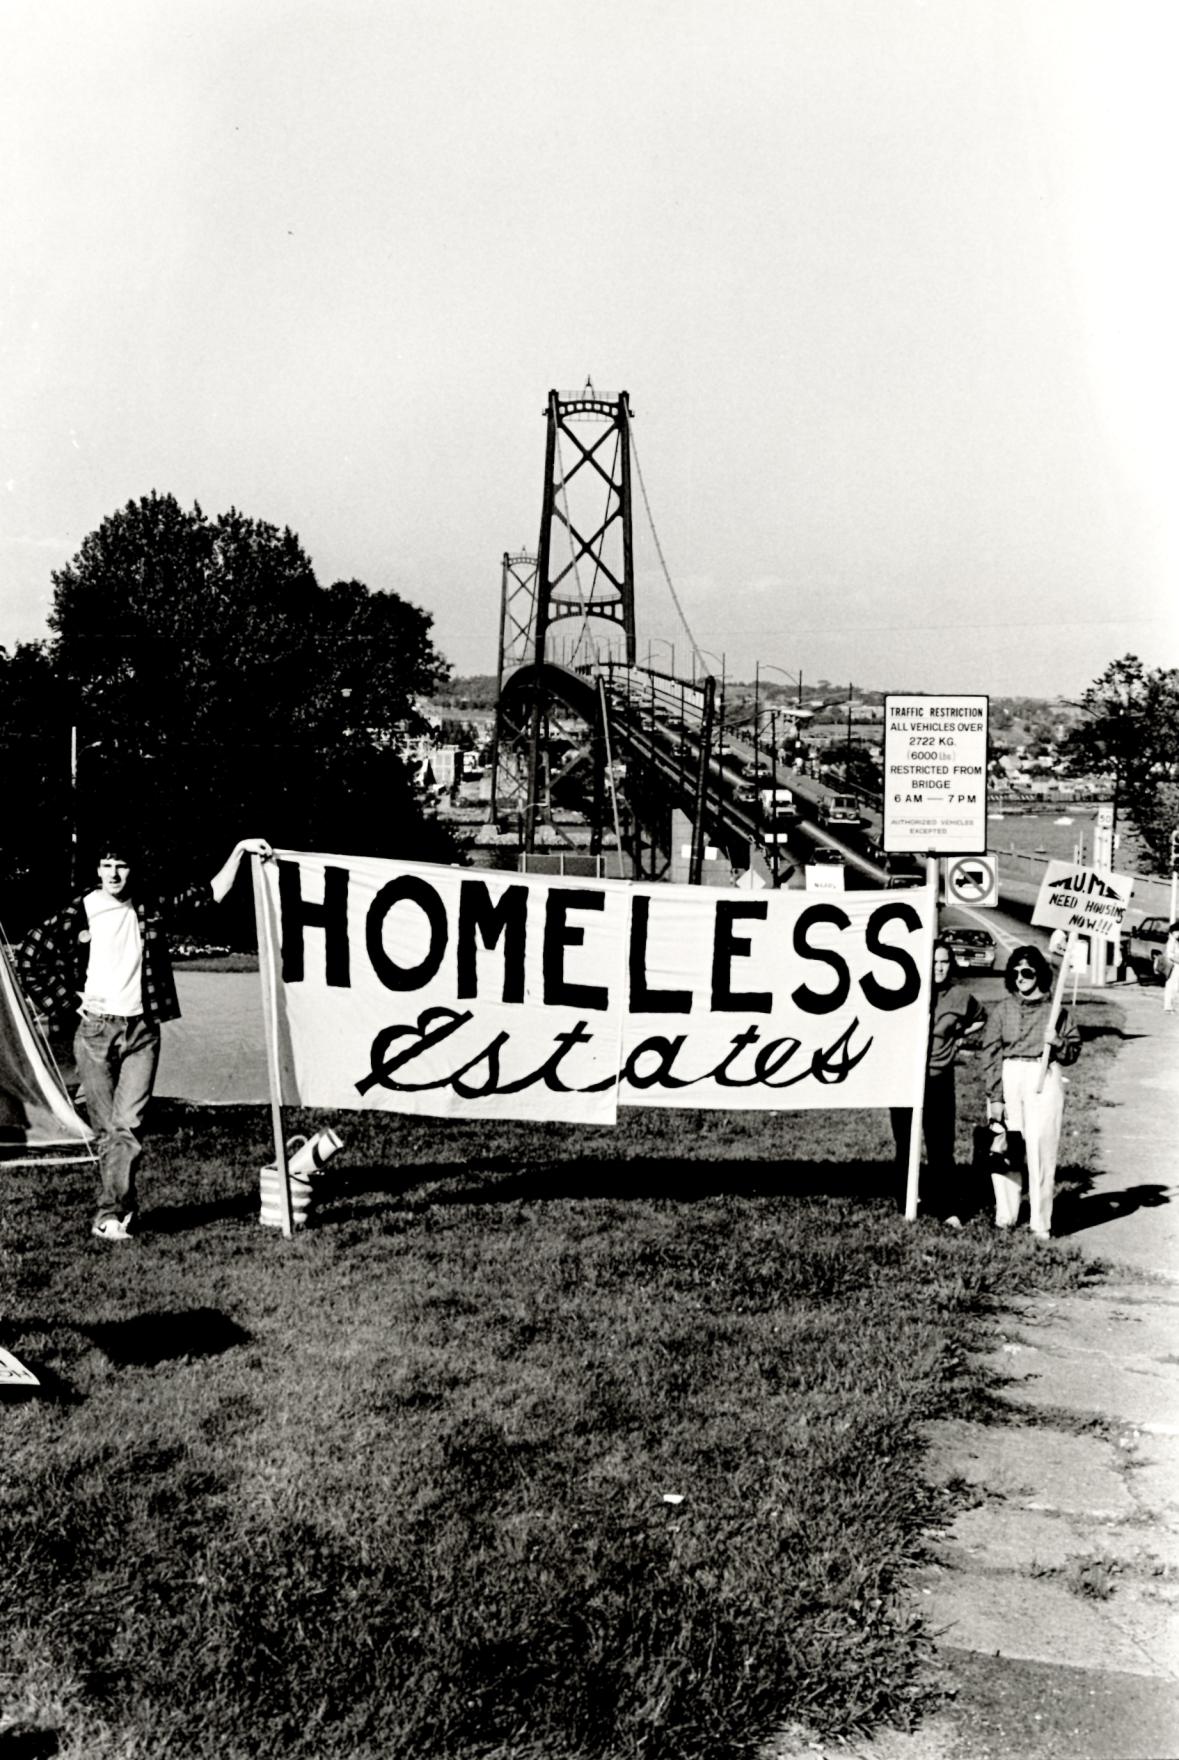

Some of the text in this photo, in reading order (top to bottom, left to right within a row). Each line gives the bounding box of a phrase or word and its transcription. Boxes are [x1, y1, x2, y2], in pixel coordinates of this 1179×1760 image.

[890, 707, 983, 718] TRAFFIC RESTRICTION
[890, 722, 984, 732] ALL VEHICLES OVER
[909, 737, 936, 746] 2722
[890, 765, 982, 775] RESTRICTED FROM
[911, 780, 951, 789] BRIDGE
[894, 794, 901, 803] 6
[947, 795, 955, 803] 7
[1049, 893, 1127, 924] NEED HOUSING
[1068, 914, 1113, 936] NOW!!!
[278, 860, 924, 1016] HOMELESS
